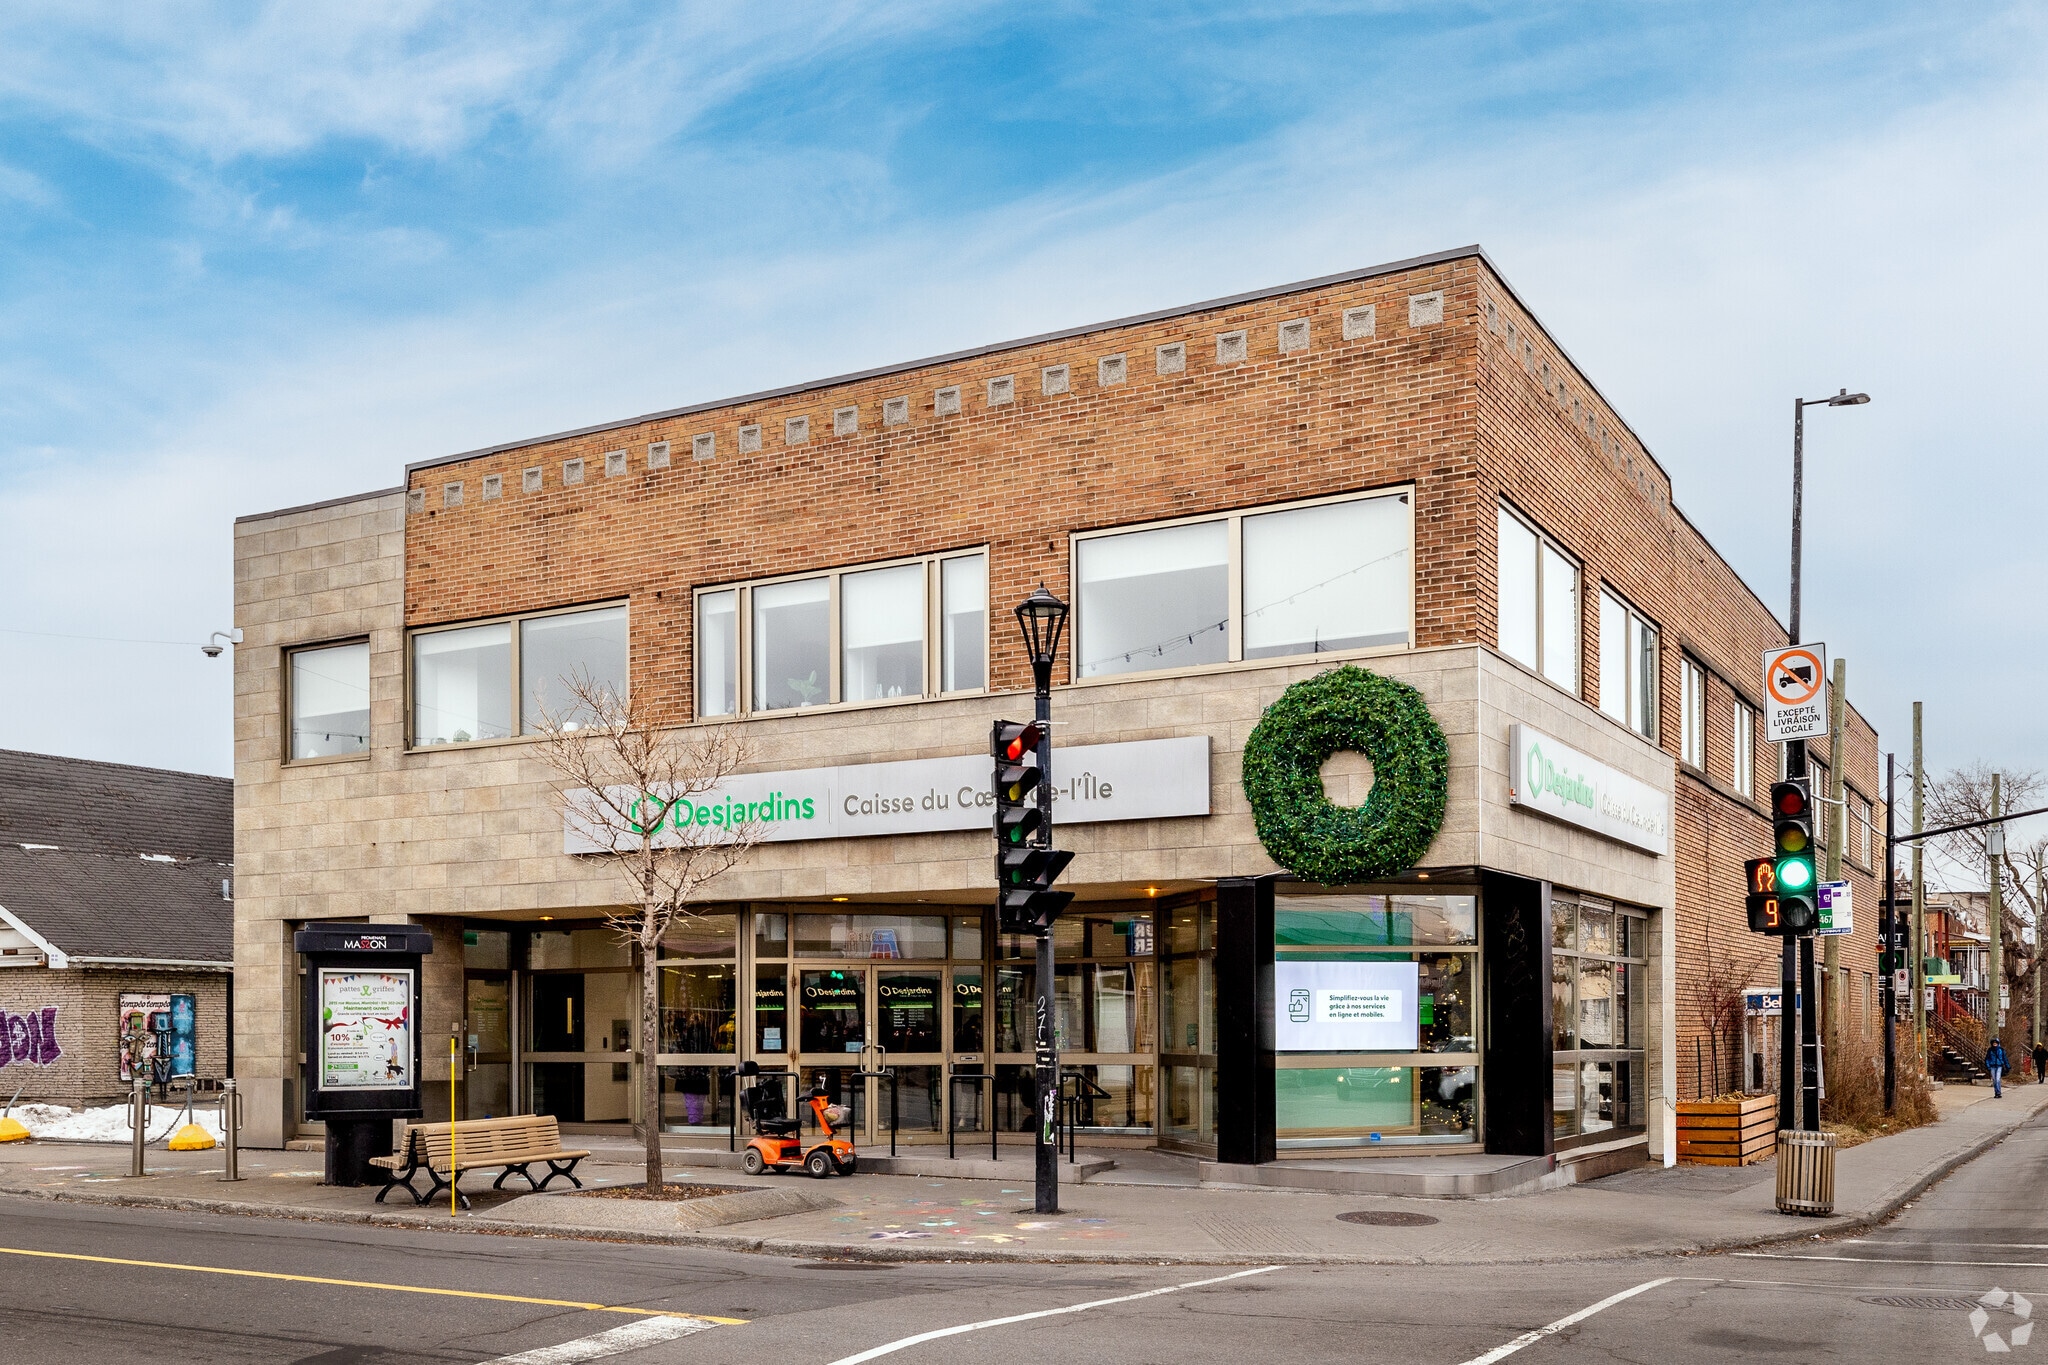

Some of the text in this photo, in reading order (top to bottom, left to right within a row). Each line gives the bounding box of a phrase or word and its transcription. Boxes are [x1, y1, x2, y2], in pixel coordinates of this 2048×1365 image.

[1777, 705, 1816, 718] EXCEPTÉ
[1773, 714, 1821, 727] LIVRAISON
[1780, 723, 1814, 735] LOCALE
[1544, 759, 1595, 809] Desjardins
[843, 793, 915, 817] Caisse
[920, 787, 950, 812] du
[674, 791, 816, 831] Desjardins
[1766, 899, 1778, 926] 9
[344, 940, 387, 949] MASSON
[339, 985, 361, 994] pattes
[372, 985, 395, 994] griffes
[817, 987, 857, 997] Desjardins
[892, 985, 933, 995] Desjardins
[1329, 994, 1373, 1002] Simplifiez-vous
[1337, 1011, 1352, 1019] ligne
[330, 1033, 350, 1041] 10%
